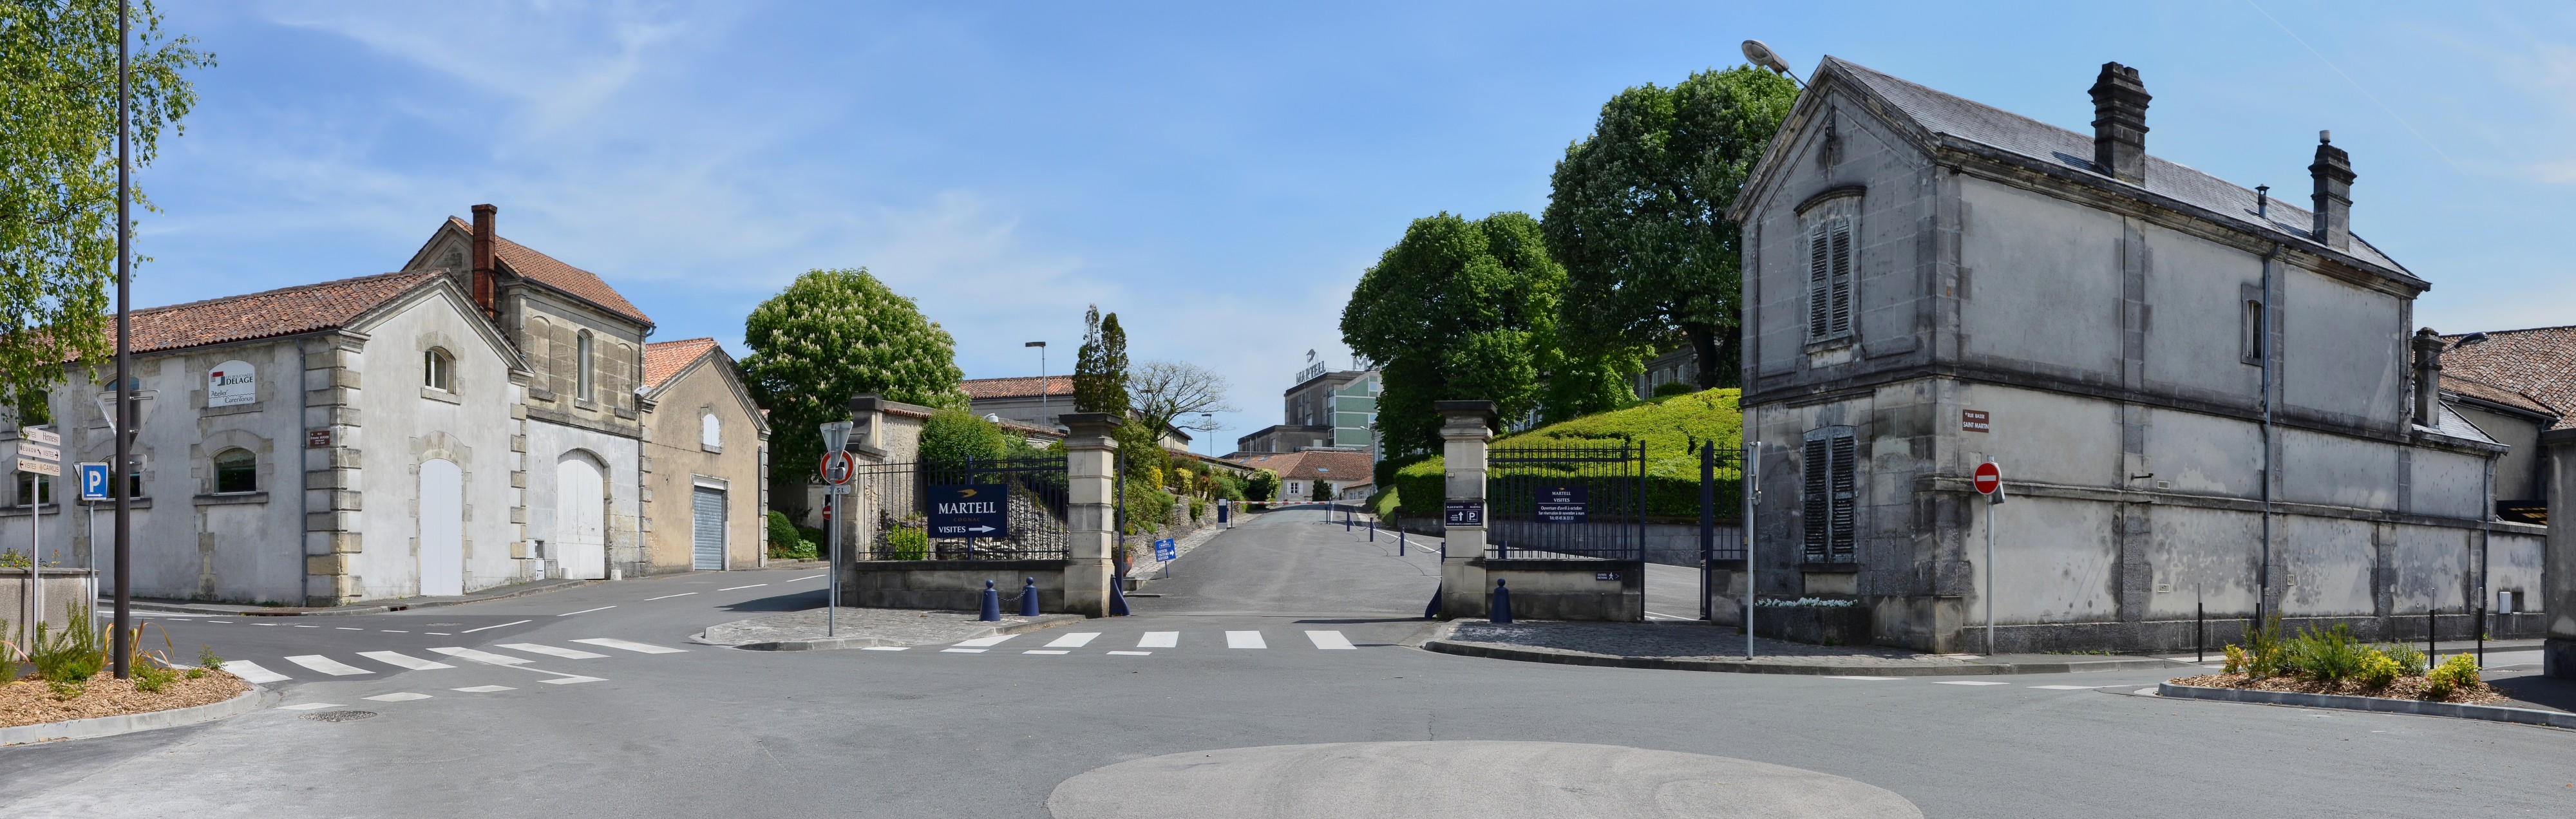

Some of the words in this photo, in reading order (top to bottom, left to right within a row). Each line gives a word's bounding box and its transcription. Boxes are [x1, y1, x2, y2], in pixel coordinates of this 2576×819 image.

[1296, 361, 1325, 384] MARTELL
[24, 429, 36, 438] SITES
[43, 431, 59, 444] Hennessy
[89, 471, 101, 492] P
[938, 502, 996, 514] MARTELL
[1469, 512, 1475, 520] P
